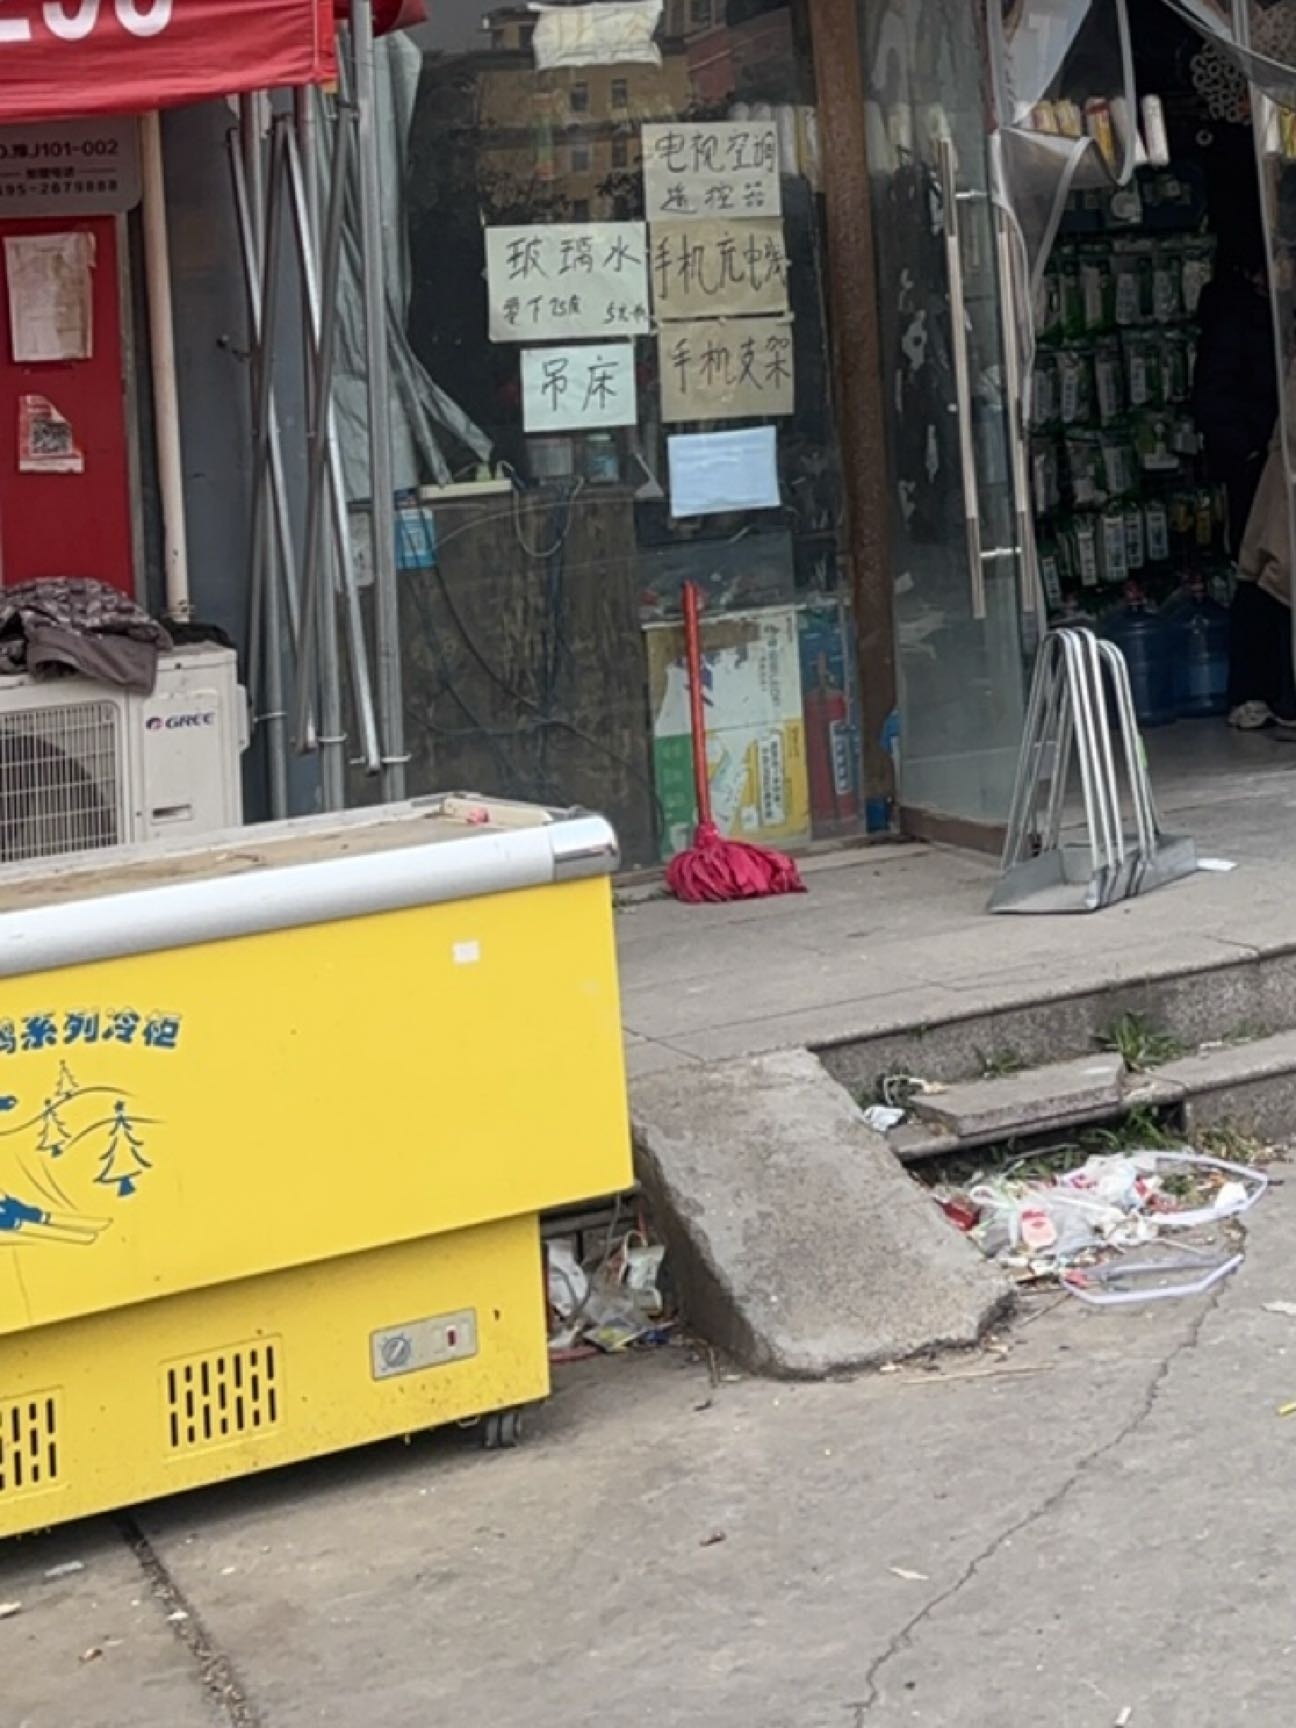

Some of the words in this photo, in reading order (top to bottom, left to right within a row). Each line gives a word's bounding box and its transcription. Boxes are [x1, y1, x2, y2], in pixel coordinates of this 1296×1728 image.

[505, 234, 643, 281] 玻璃水
[540, 355, 618, 414] 吊床
[670, 334, 792, 395] 手机支架
